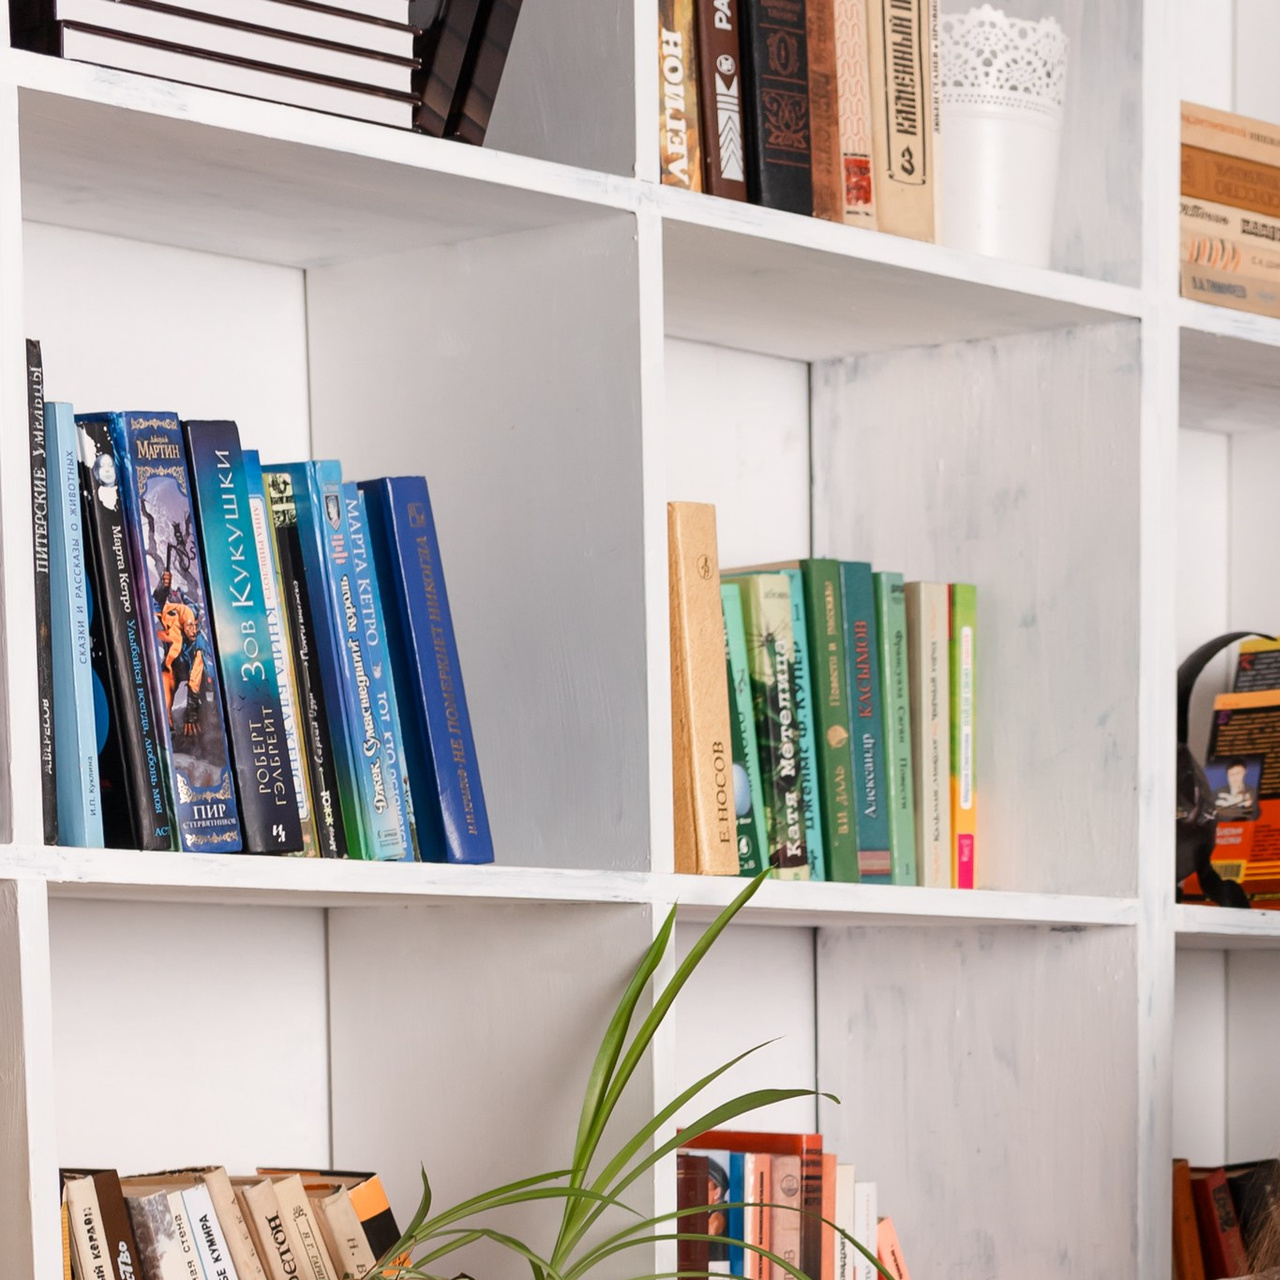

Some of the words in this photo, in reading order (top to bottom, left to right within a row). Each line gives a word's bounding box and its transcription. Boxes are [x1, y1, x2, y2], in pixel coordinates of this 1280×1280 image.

[661, 28, 690, 185] ЛЕГИОН
[29, 366, 46, 458] УМЕЛЬЦЫ
[138, 440, 181, 460] МАРТИН
[34, 465, 48, 573] ПИТЕРСКИЕ
[65, 450, 78, 517] ЖИВОТНЫХ
[70, 522, 79, 533] О
[72, 536, 83, 596] РАССКАЗЫ
[76, 599, 84, 611] И
[112, 525, 125, 573] Марта
[120, 576, 132, 613] Кетро
[346, 498, 365, 575] МАРТА
[359, 579, 380, 646] КЕТРО
[78, 618, 88, 664] СКАЗКИ
[853, 619, 873, 719] КАСЫМОВ
[128, 619, 143, 685] Улыбайся
[153, 789, 164, 813] моя
[774, 638, 797, 778] Метелица
[86, 754, 95, 795] Куклина
[249, 718, 272, 796] РОБЕРТ
[261, 707, 288, 806] ГЭЛБРЕЙТ
[863, 733, 878, 818] Александр
[193, 803, 226, 820] ПИР
[785, 790, 802, 857] Катя
[198, 1213, 223, 1263] КУМИРА
